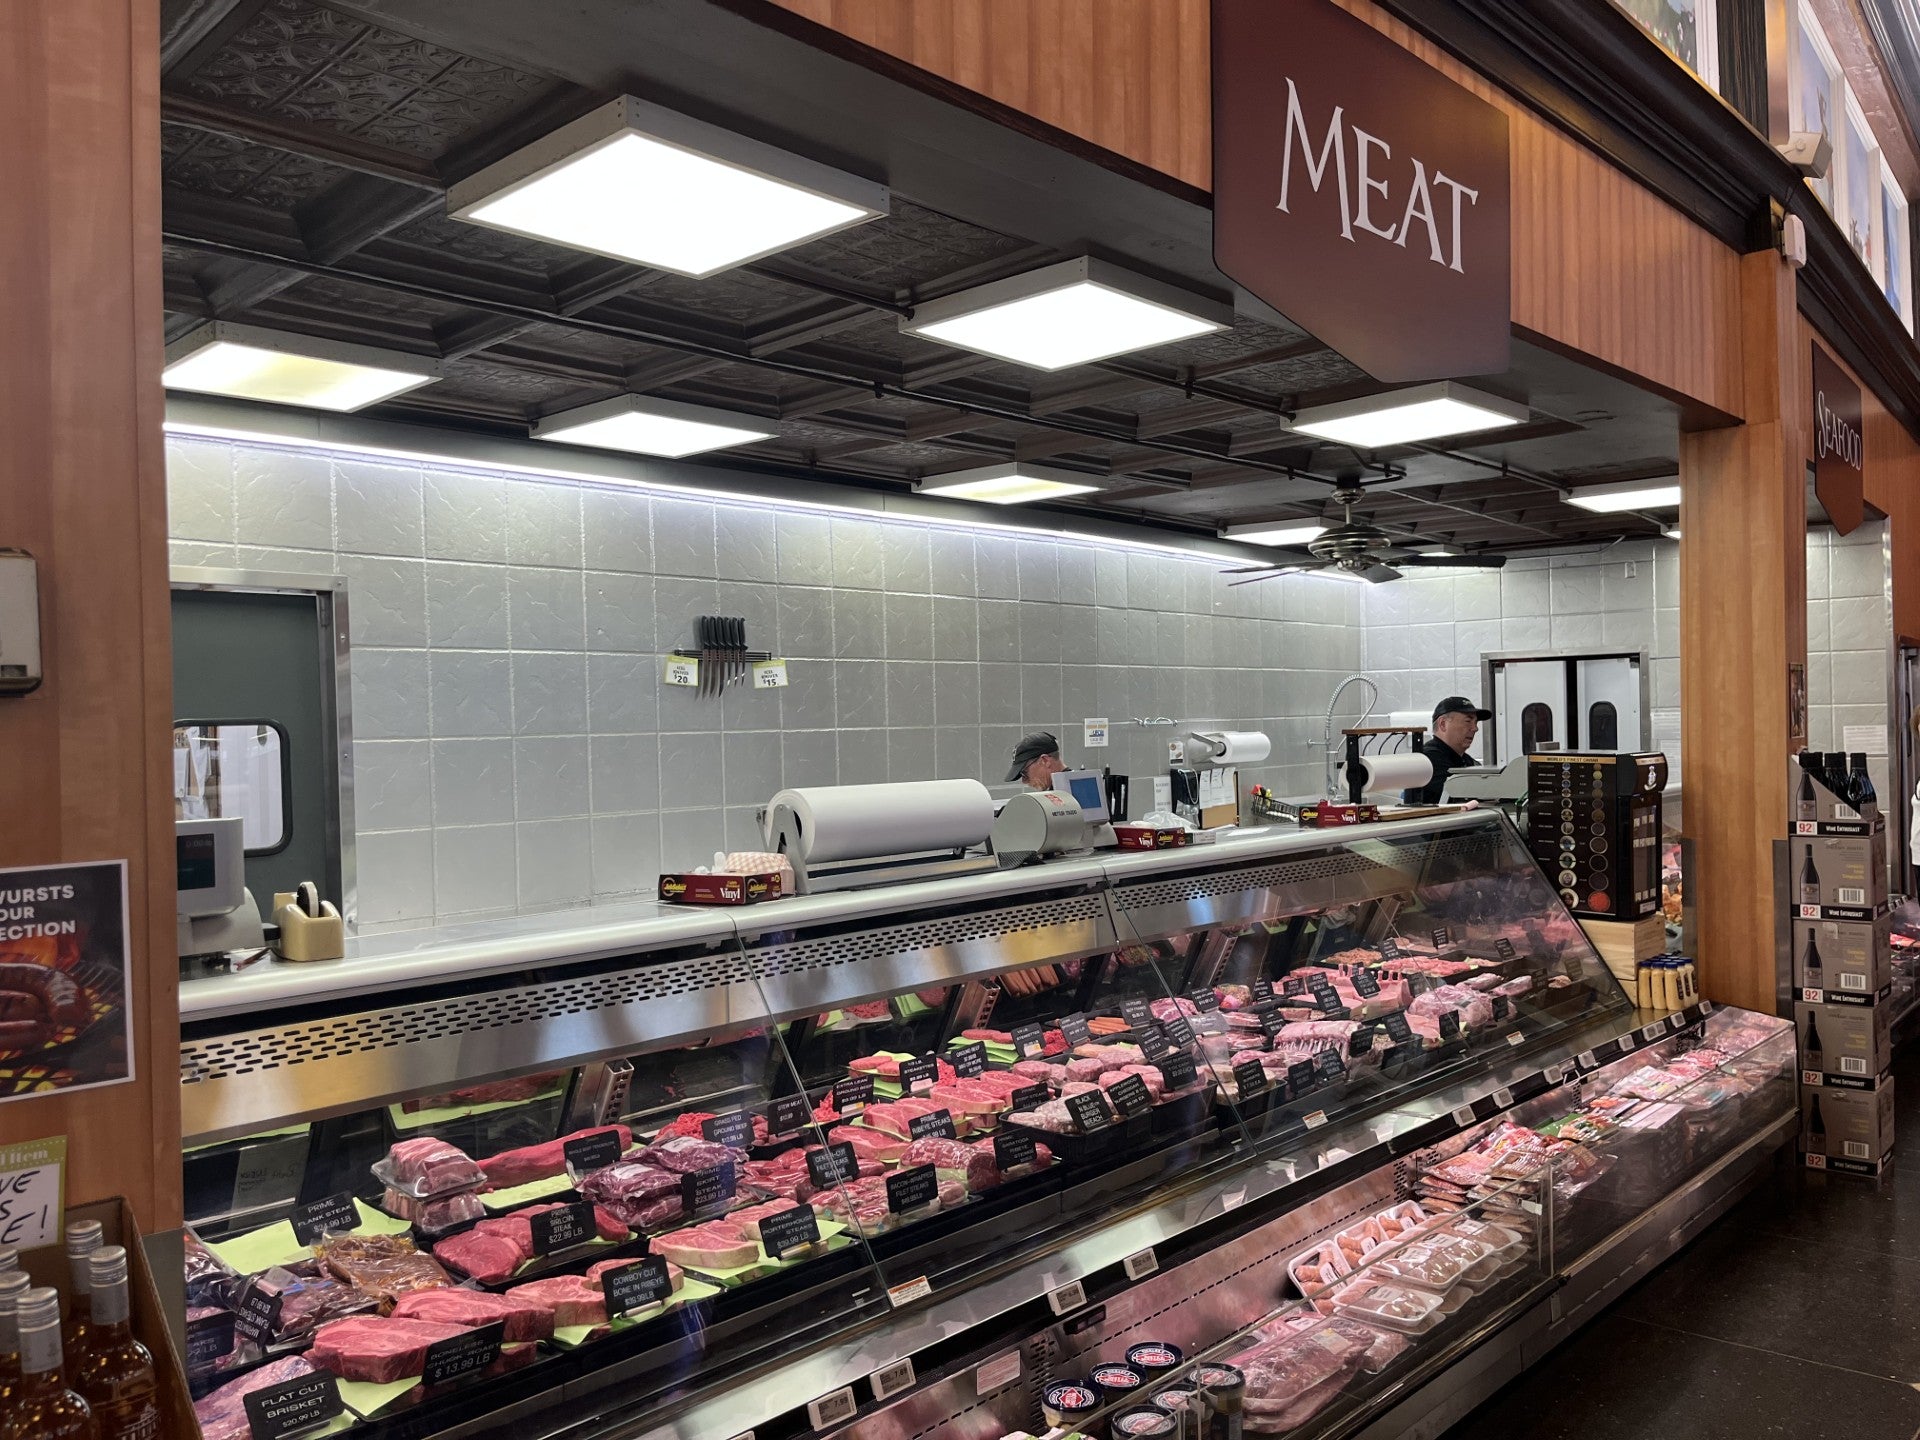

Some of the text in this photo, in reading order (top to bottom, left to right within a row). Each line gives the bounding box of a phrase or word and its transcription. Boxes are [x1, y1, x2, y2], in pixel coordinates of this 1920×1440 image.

[1275, 76, 1480, 275] MEAT
[1818, 390, 1862, 471] SEAFOOD
[1341, 814, 1357, 824] Vinyl
[1798, 823, 1812, 833] 92
[1138, 836, 1153, 848] Vinyl
[719, 886, 741, 902] Vinyl
[1802, 905, 1816, 916] 92
[1804, 989, 1818, 1001] 92
[853, 1077, 868, 1085] LEAN
[1804, 1072, 1818, 1083] 92
[1074, 1095, 1092, 1105] BLACK
[919, 1113, 937, 1124] PRIME
[931, 1116, 951, 1129] STEAKS
[713, 1125, 735, 1136] GROUND
[939, 1128, 947, 1136] LB
[1807, 1154, 1821, 1166] 92
[718, 1189, 727, 1198] LB
[307, 1198, 335, 1214] PRIME
[297, 1204, 352, 1227] FLANK STEAK
[550, 1208, 571, 1218] PRIME
[770, 1212, 793, 1224] PRIME
[340, 1214, 352, 1225] LB
[549, 1214, 575, 1227] SIRLOIN
[553, 1223, 572, 1234] STEAK
[573, 1226, 583, 1237] LB
[786, 1223, 813, 1235] STEAKS
[800, 1231, 809, 1241] LB
[612, 1271, 643, 1286] COWBOY
[643, 1267, 657, 1277] CUT
[613, 1285, 632, 1298] BONE
[476, 1352, 491, 1365] LB
[261, 1382, 327, 1408] FLAT CUT
[266, 1395, 326, 1419] BRISKET
[282, 1409, 320, 1428] $20.99 LB
